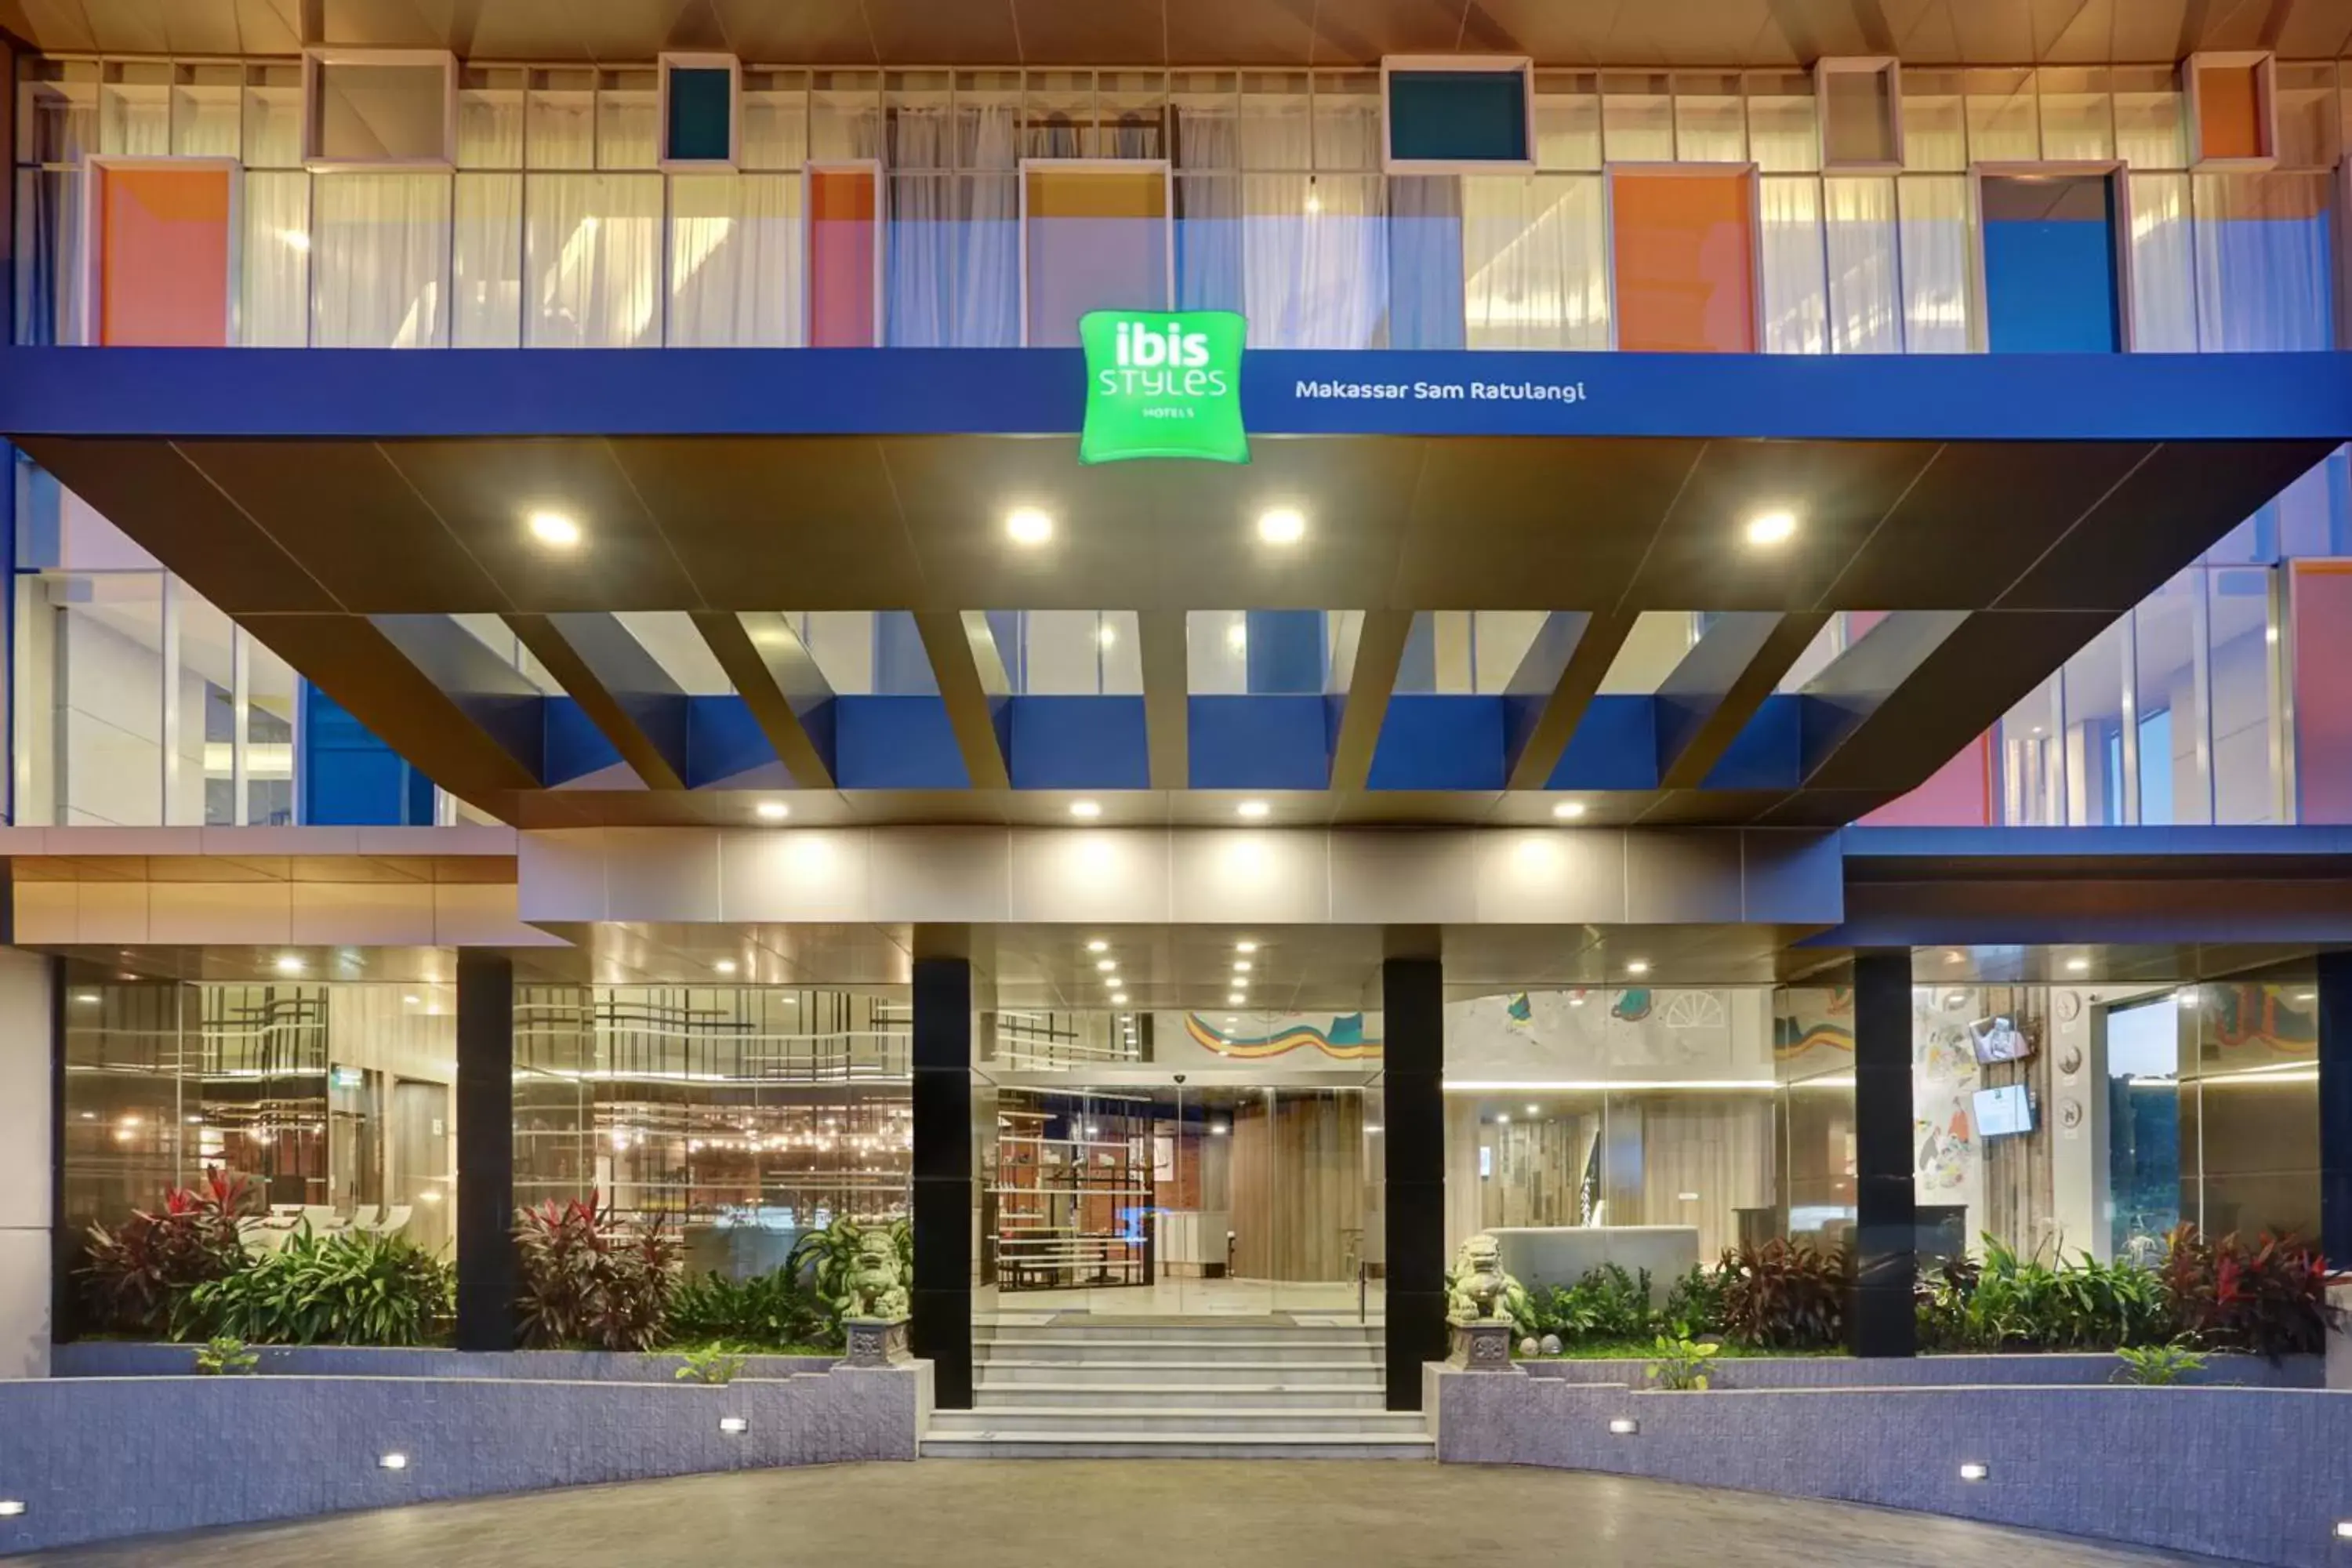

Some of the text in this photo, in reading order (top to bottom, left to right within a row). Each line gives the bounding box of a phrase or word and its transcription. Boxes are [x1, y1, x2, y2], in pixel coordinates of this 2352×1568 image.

[1116, 321, 1210, 367] ibis
[1295, 380, 1587, 404] Makassar Sam Ratulangi
[1142, 408, 1195, 419] HOTELS
